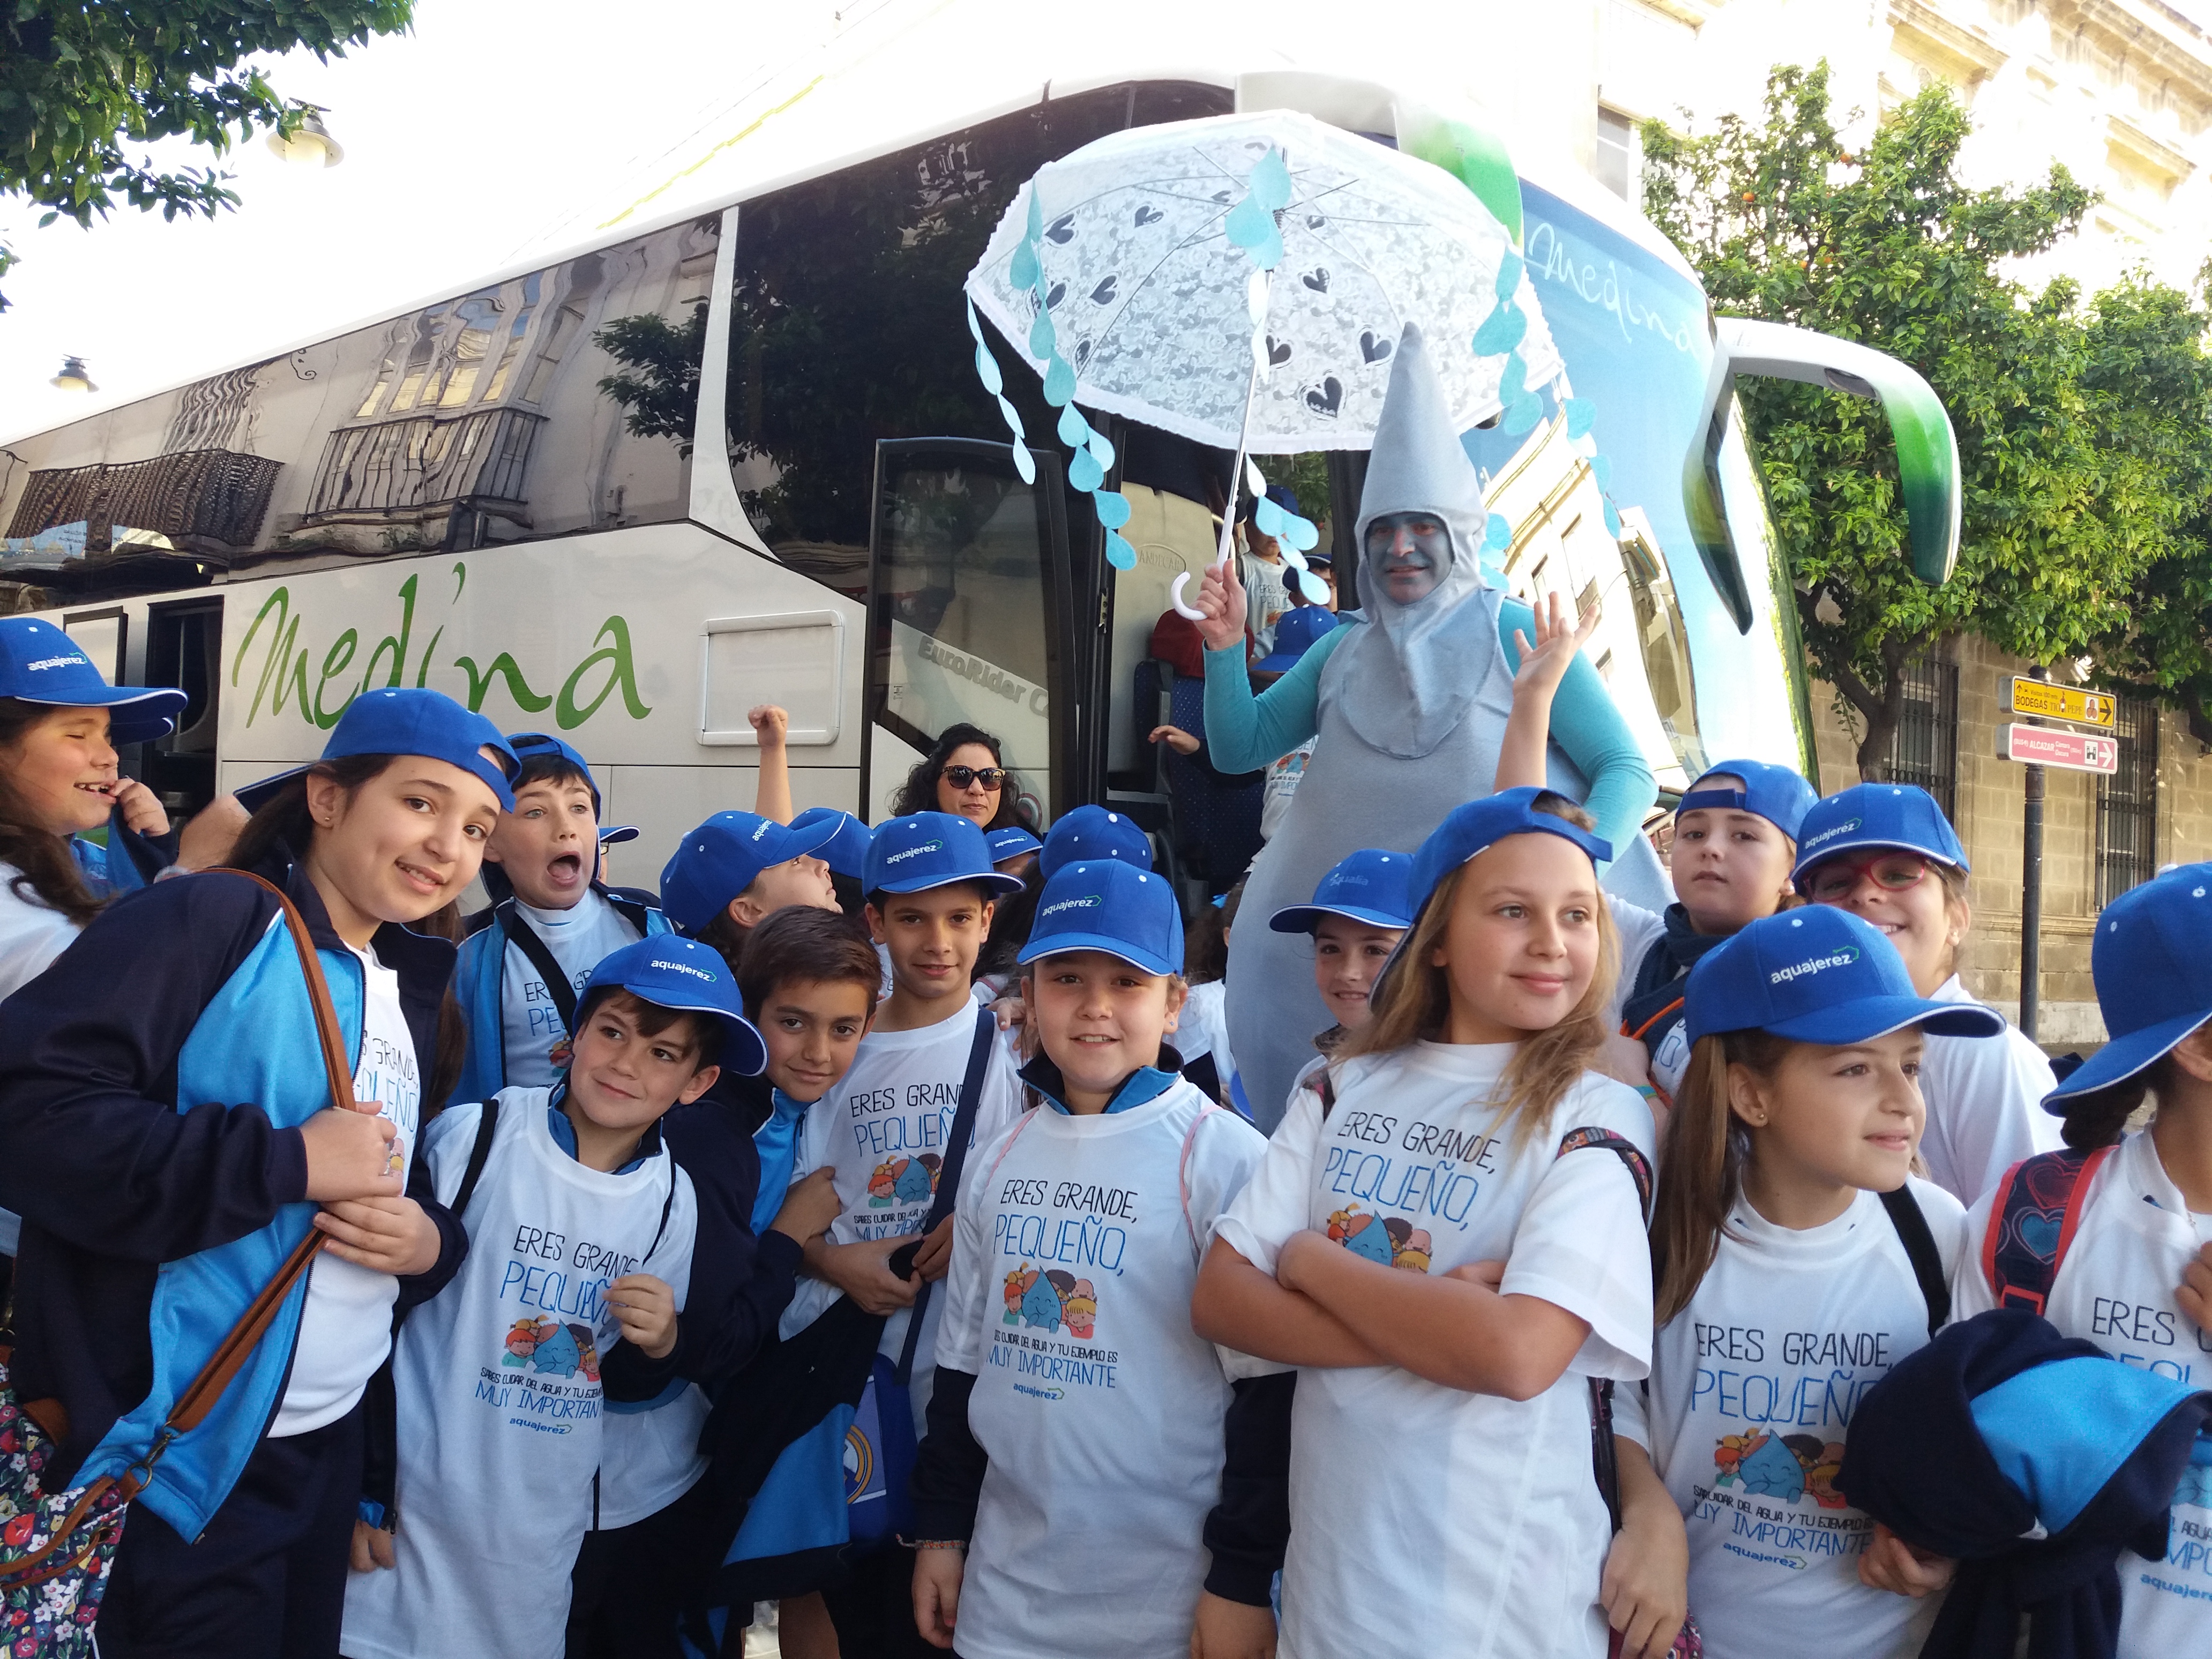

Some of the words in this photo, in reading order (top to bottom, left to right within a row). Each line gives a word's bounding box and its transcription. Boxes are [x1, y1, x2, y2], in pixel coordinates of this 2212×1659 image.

[232, 562, 653, 731] Medina
[27, 656, 86, 671] aquajerez
[918, 636, 1026, 703] EuroRider
[2016, 695, 2047, 709] BODEGAS
[2068, 704, 2083, 714] PEPE
[2029, 741, 2054, 751] ALCAZAR
[995, 836, 1026, 848] aquajerez
[1805, 822, 1855, 849] aquajerez
[886, 845, 937, 864] aquajerez
[1042, 897, 1093, 916] aquajerez
[651, 960, 711, 982] aquajerez
[1771, 953, 1853, 984] aquajerez
[850, 1088, 895, 1118] ERES
[1337, 1111, 1397, 1144] ERES
[1403, 1122, 1501, 1174] GRANDE,
[1000, 1179, 1048, 1206] ERES
[1053, 1182, 1138, 1223] GRANDE,
[1319, 1147, 1479, 1231] PEQUEÑO,
[854, 1215, 871, 1224] SABES
[873, 1213, 895, 1223] CUIDAR
[513, 1225, 564, 1260] ERES
[993, 1214, 1125, 1277] PEQUEÑO,
[499, 1260, 612, 1326] PEQUEÑ
[2092, 1297, 2175, 1346] ERES
[1021, 1334, 1029, 1348] DEL
[1032, 1339, 1047, 1352] AGUA
[1050, 1342, 1056, 1354] Y
[1057, 1343, 1069, 1356] TU
[1071, 1346, 1105, 1362] EJEMPLO
[1107, 1351, 1118, 1363] ES
[1695, 1322, 1764, 1363] ERES
[1784, 1332, 1893, 1371] GRANDE,
[986, 1344, 1012, 1368] MUY
[1018, 1350, 1117, 1388] IMPORTANTE
[475, 1380, 512, 1408] MUY
[481, 1367, 501, 1384] SABES
[502, 1373, 524, 1386] CUIDAR
[526, 1378, 537, 1390] DEL
[541, 1383, 562, 1396] AGUA
[564, 1387, 571, 1396] Y
[573, 1387, 585, 1398] TU
[1013, 1382, 1057, 1400] aquajerez
[510, 1418, 566, 1434] aquajerez
[1694, 1499, 1721, 1524] UY
[1737, 1499, 1752, 1514] DEL
[1757, 1506, 1783, 1523] AGUA
[1787, 1513, 1796, 1524] Y
[1799, 1514, 1815, 1527] TU
[1723, 1542, 1797, 1569] aquajerez
